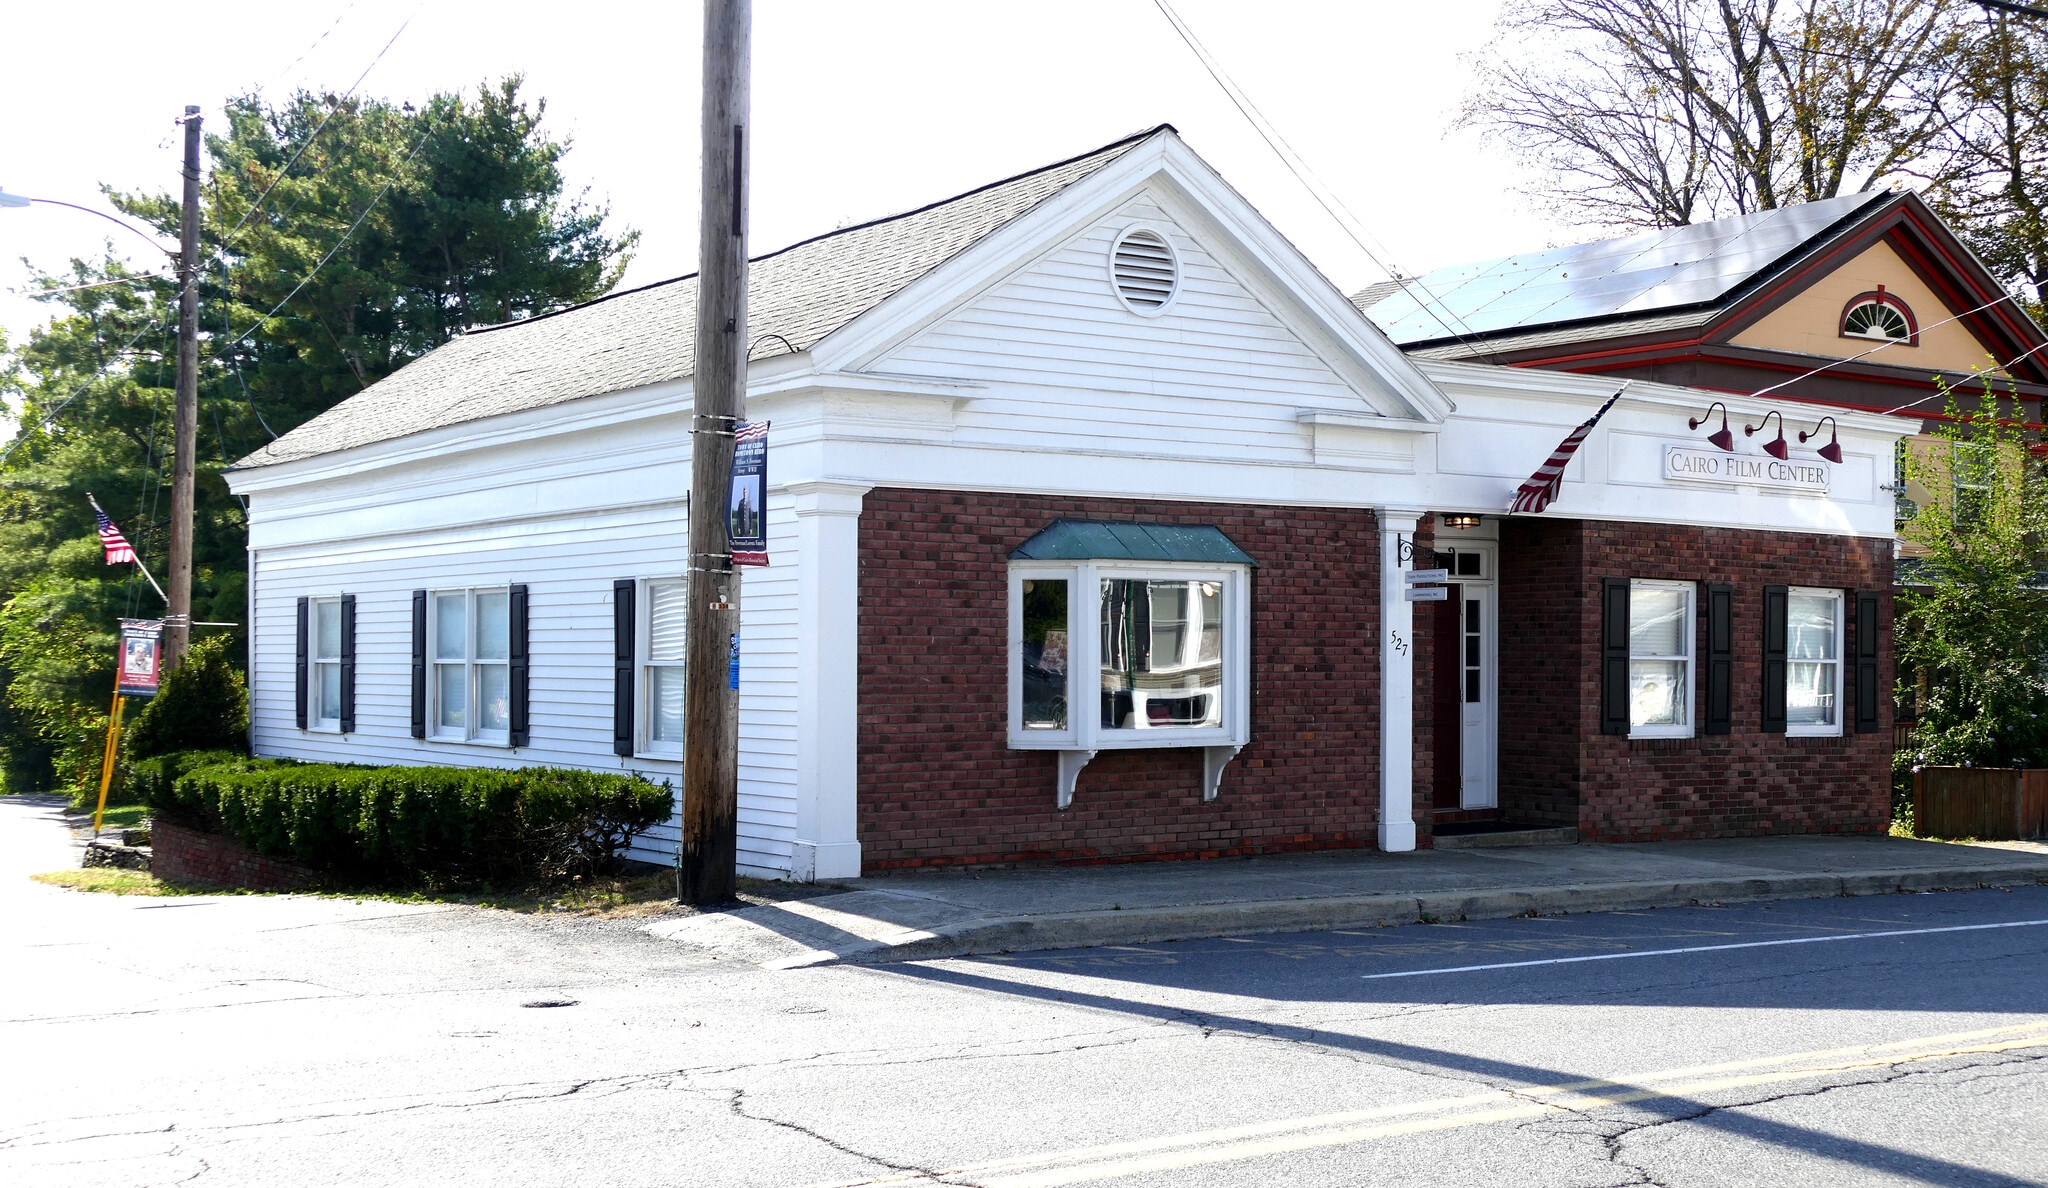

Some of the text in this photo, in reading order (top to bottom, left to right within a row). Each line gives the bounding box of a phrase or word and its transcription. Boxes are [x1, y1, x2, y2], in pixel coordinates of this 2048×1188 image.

[1671, 453, 1825, 484] CAIRO FILM CENTER
[1391, 630, 1408, 656] 527
